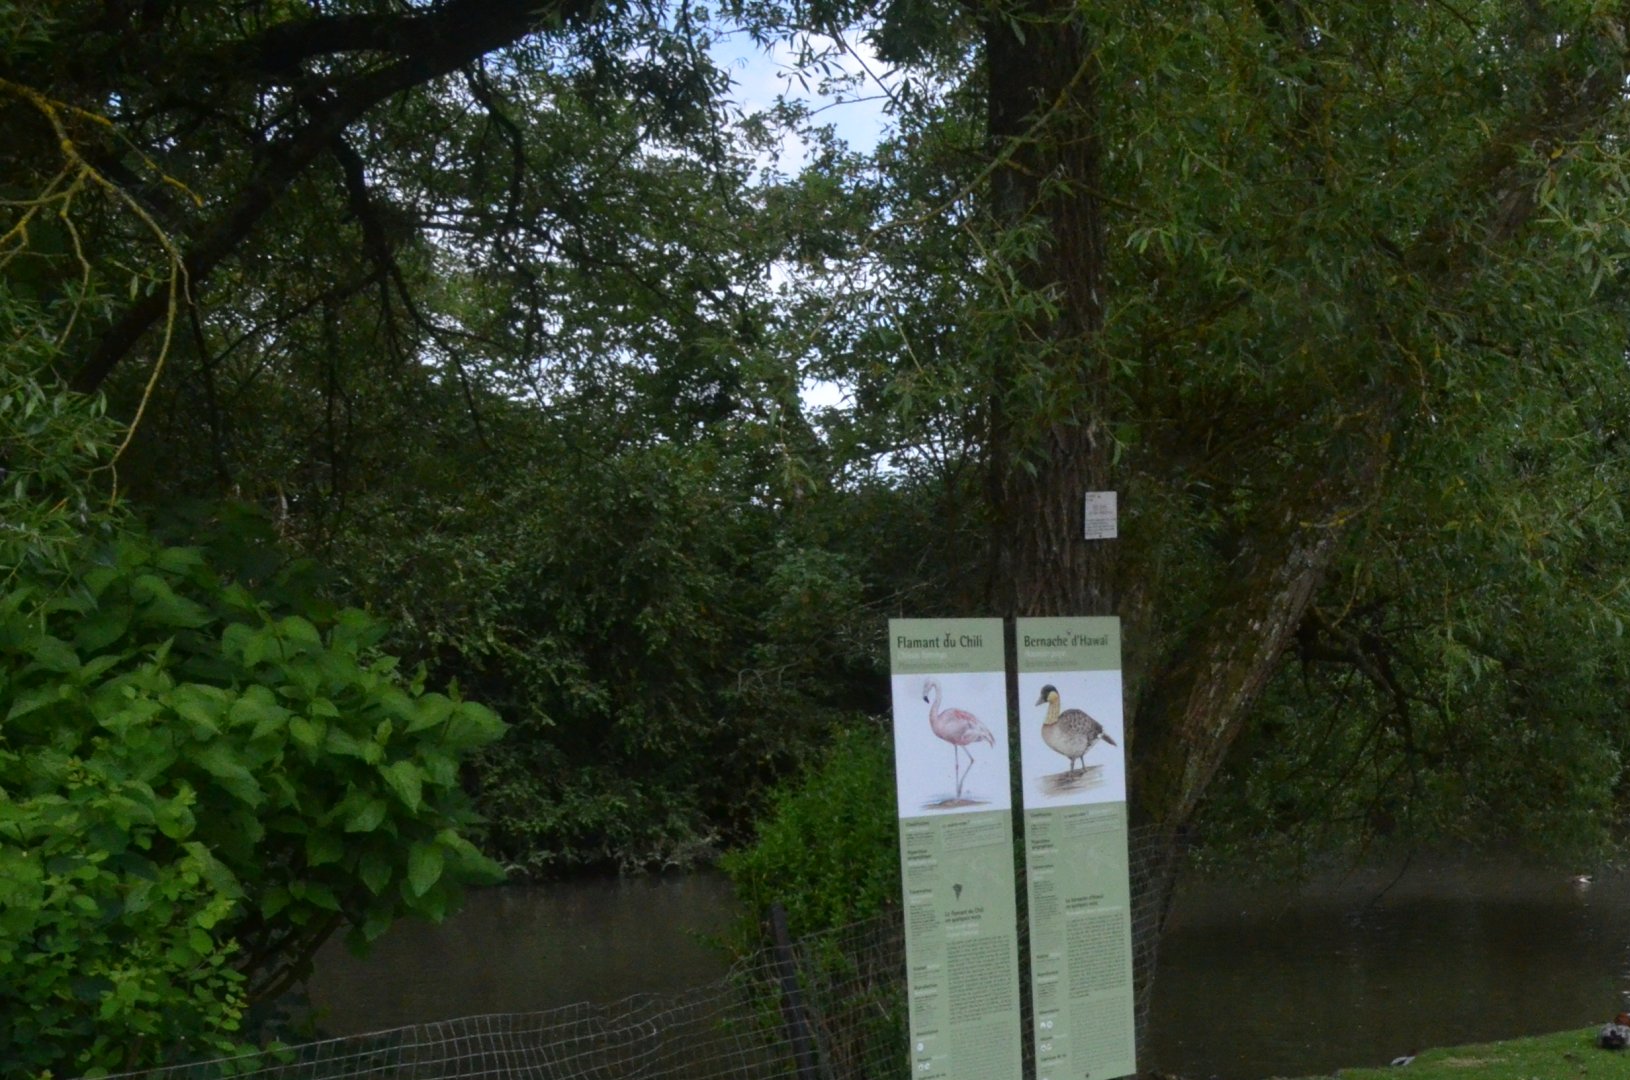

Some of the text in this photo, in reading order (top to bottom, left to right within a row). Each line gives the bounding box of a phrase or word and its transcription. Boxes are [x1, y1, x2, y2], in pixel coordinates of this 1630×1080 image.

[897, 634, 983, 649] Flamant du Chili
[1023, 634, 1068, 648] Bernache
